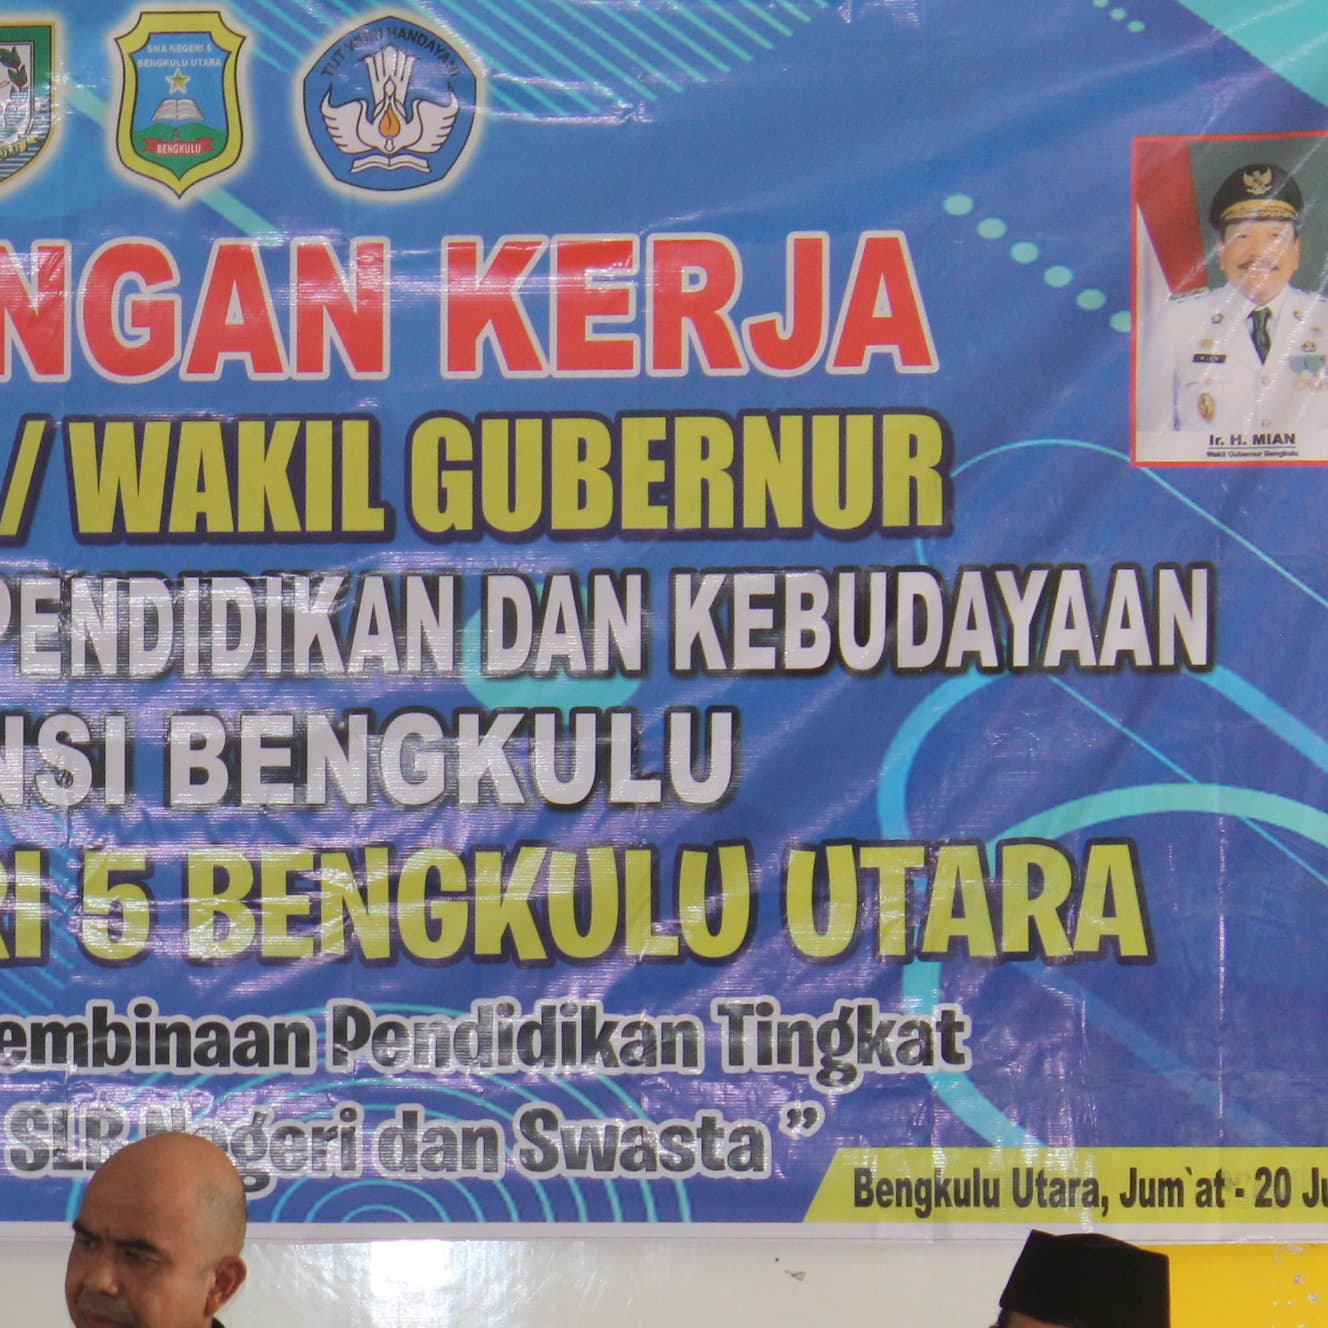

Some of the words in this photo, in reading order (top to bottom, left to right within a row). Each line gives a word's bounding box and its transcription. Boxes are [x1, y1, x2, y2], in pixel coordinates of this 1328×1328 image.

[169, 43, 203, 53] NEGERI
[321, 48, 348, 77] TUT
[156, 143, 202, 153] BENGKULU
[443, 233, 937, 377] KERJA
[65, 416, 387, 536] WAKIL
[407, 411, 946, 535] GUBERNUR
[1209, 434, 1225, 446] Ir.
[1230, 434, 1247, 446] H.
[1252, 433, 1296, 445] MIAN
[485, 571, 644, 674] DAN
[672, 567, 1210, 672] KEBUDAYAAN
[167, 708, 735, 808] BENGKULU
[77, 846, 152, 962] 5
[185, 844, 753, 961] BENGKULU
[786, 842, 1151, 959] UTARA
[332, 1001, 700, 1070] Pendidikan
[715, 1002, 969, 1086] Tingkat
[376, 1107, 499, 1174] dan
[516, 1105, 768, 1174] Swasta
[852, 1167, 1001, 1219] Bengkulu
[1011, 1166, 1110, 1217] Utara,
[1254, 1165, 1293, 1209] 20
